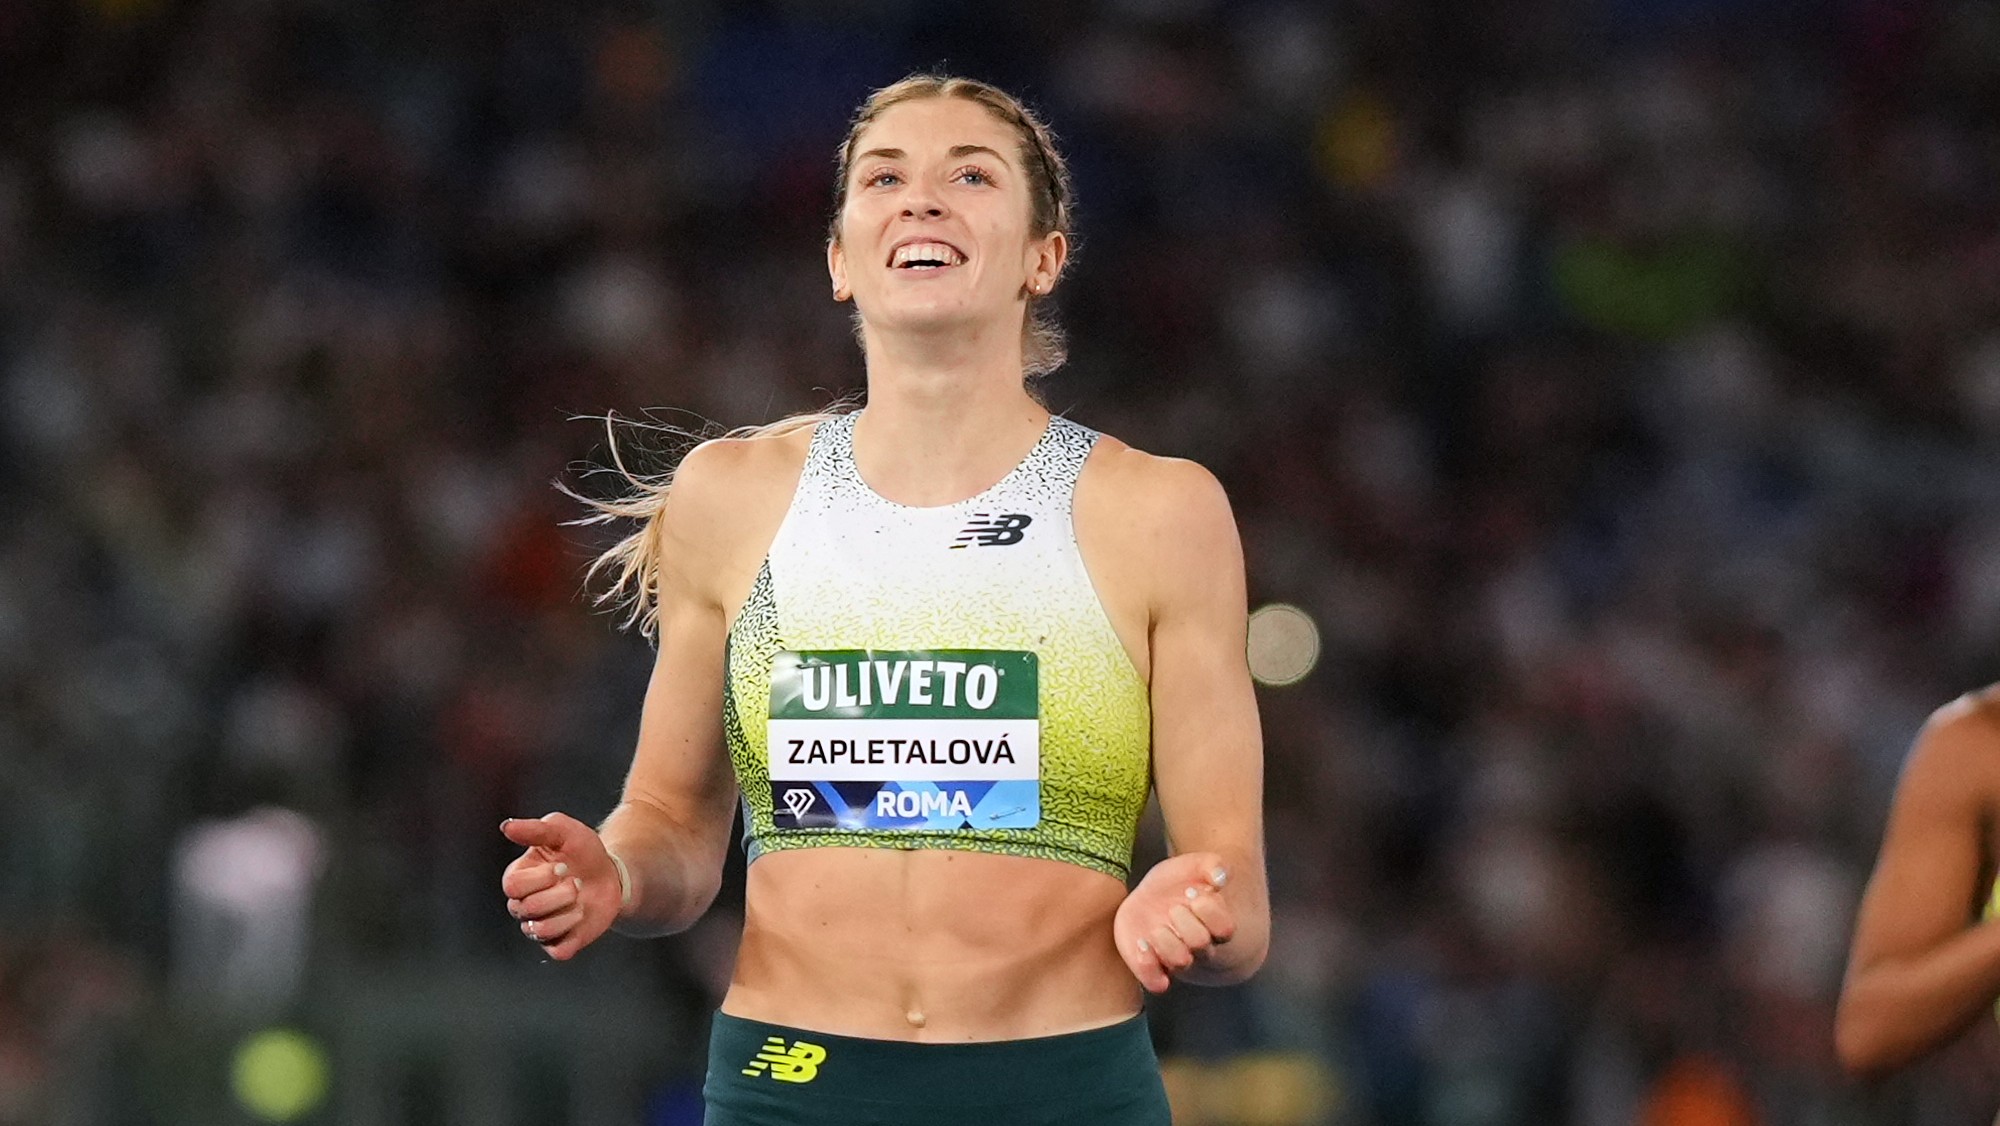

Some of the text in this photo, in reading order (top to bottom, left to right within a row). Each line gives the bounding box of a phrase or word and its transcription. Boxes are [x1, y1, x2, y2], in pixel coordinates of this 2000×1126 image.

[801, 660, 999, 711] ULIVETO
[788, 733, 1016, 765] ZAPLETALOVÁ
[876, 790, 973, 818] ROMA
